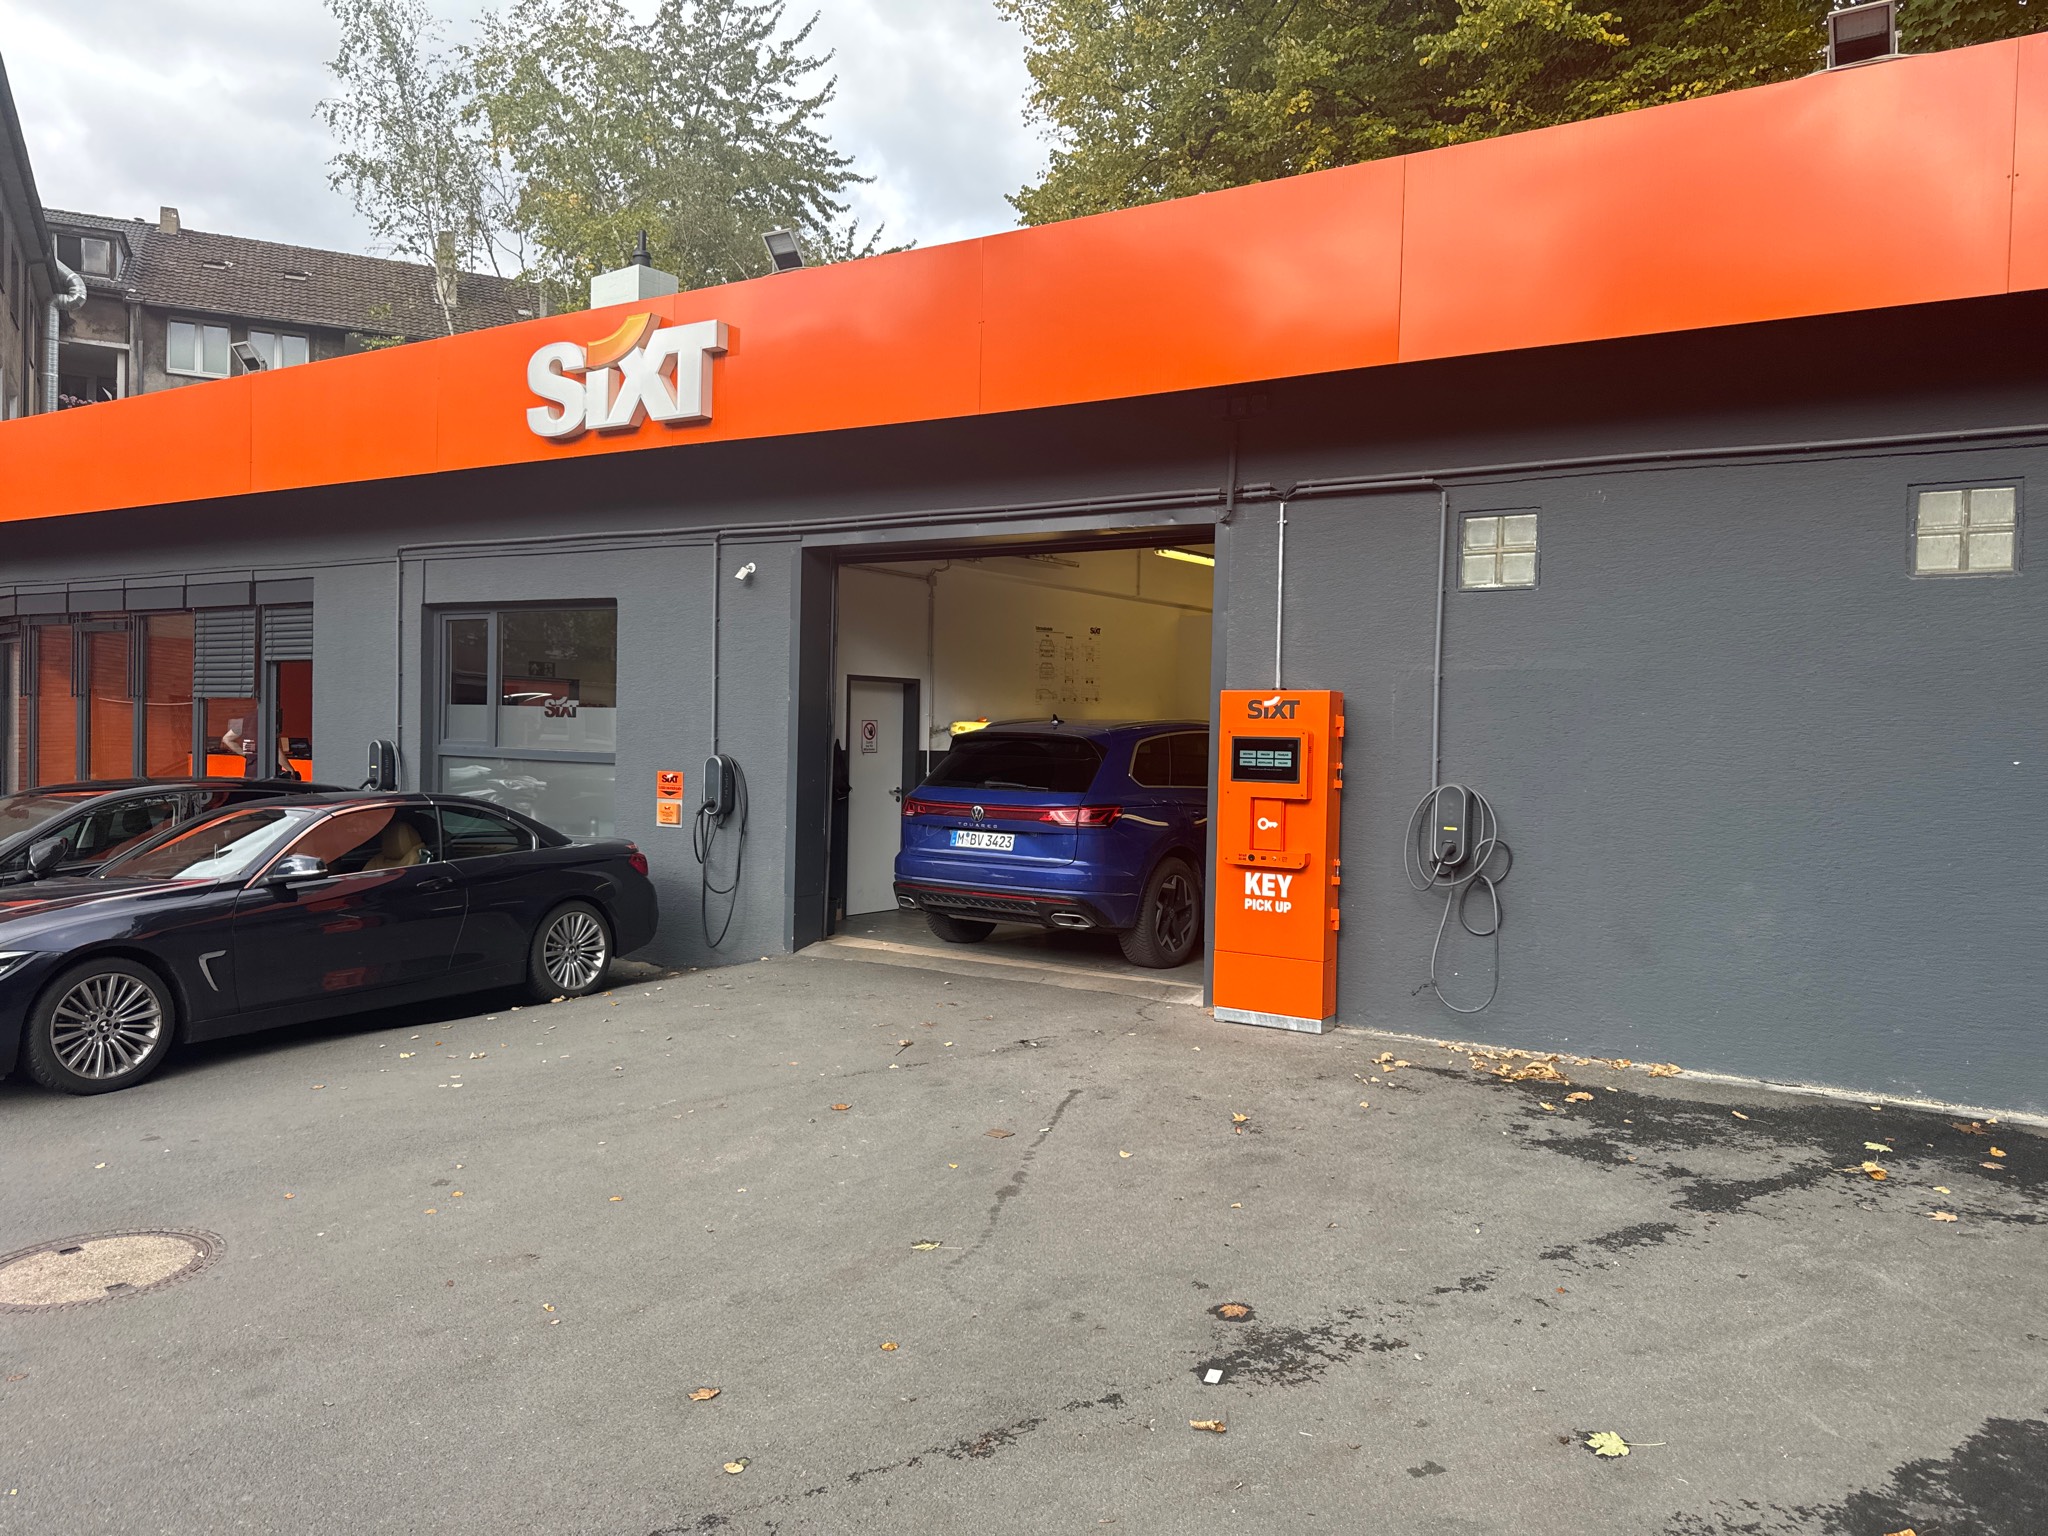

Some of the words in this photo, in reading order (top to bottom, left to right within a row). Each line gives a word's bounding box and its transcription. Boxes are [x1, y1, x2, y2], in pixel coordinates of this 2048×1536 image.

[957, 821, 998, 829] TOUAREG
[985, 834, 1013, 849] 3423
[1244, 871, 1293, 899] KEY
[1244, 897, 1273, 912] PICK
[1275, 900, 1292, 914] UP
